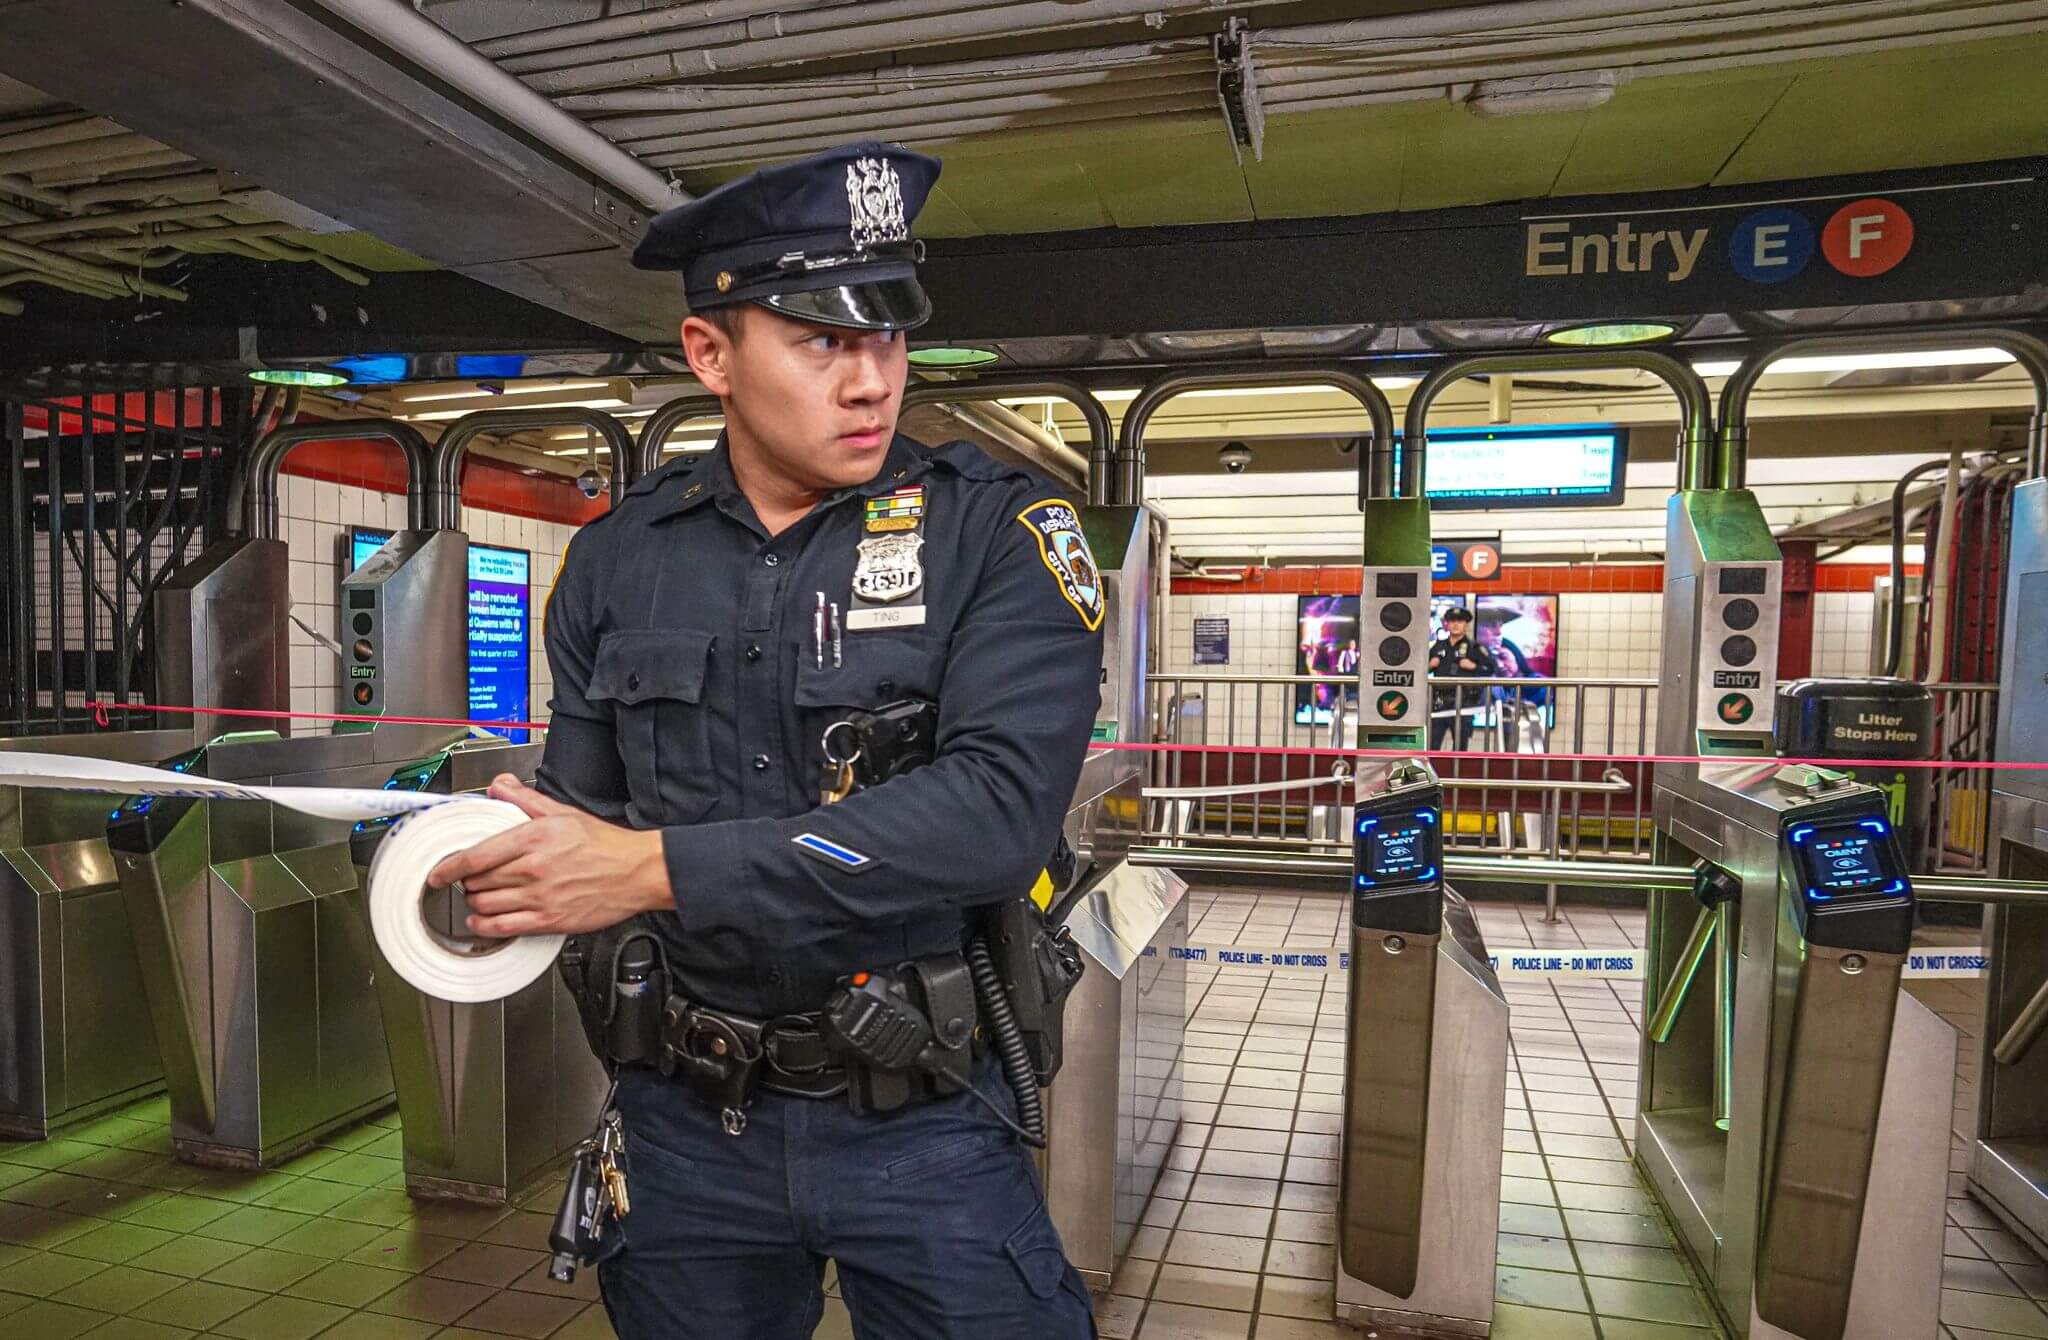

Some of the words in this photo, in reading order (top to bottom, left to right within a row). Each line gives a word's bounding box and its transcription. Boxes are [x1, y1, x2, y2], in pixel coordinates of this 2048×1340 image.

[1526, 222, 1709, 281] Entry
[1754, 224, 1790, 267] E
[1849, 215, 1885, 258] F
[1432, 553, 1447, 572] E
[1472, 552, 1488, 571] F
[1047, 551, 1072, 581] CITY
[1067, 586, 1083, 604] OF
[873, 612, 899, 622] TING
[351, 667, 376, 679] Entry
[1374, 671, 1412, 686] Entry
[1715, 672, 1759, 688] Entry
[1859, 713, 1903, 726] Litter
[1835, 726, 1881, 741] Stops
[1884, 729, 1918, 741] Here
[1383, 836, 1415, 847] OMNY
[1824, 847, 1863, 858] OMNY
[1219, 951, 1245, 964] POLICE
[1246, 952, 1263, 964] LINE
[1271, 953, 1282, 965] DO
[1284, 954, 1300, 966] NOT
[1301, 954, 1327, 967] CROSS
[1512, 957, 1542, 969] POLICE
[1543, 957, 1562, 969] LINE
[1571, 957, 1583, 969] DO
[1586, 957, 1603, 970] NOT
[1604, 957, 1633, 970] CROSS
[1911, 956, 1924, 969] DO
[1926, 956, 1946, 969] NOT
